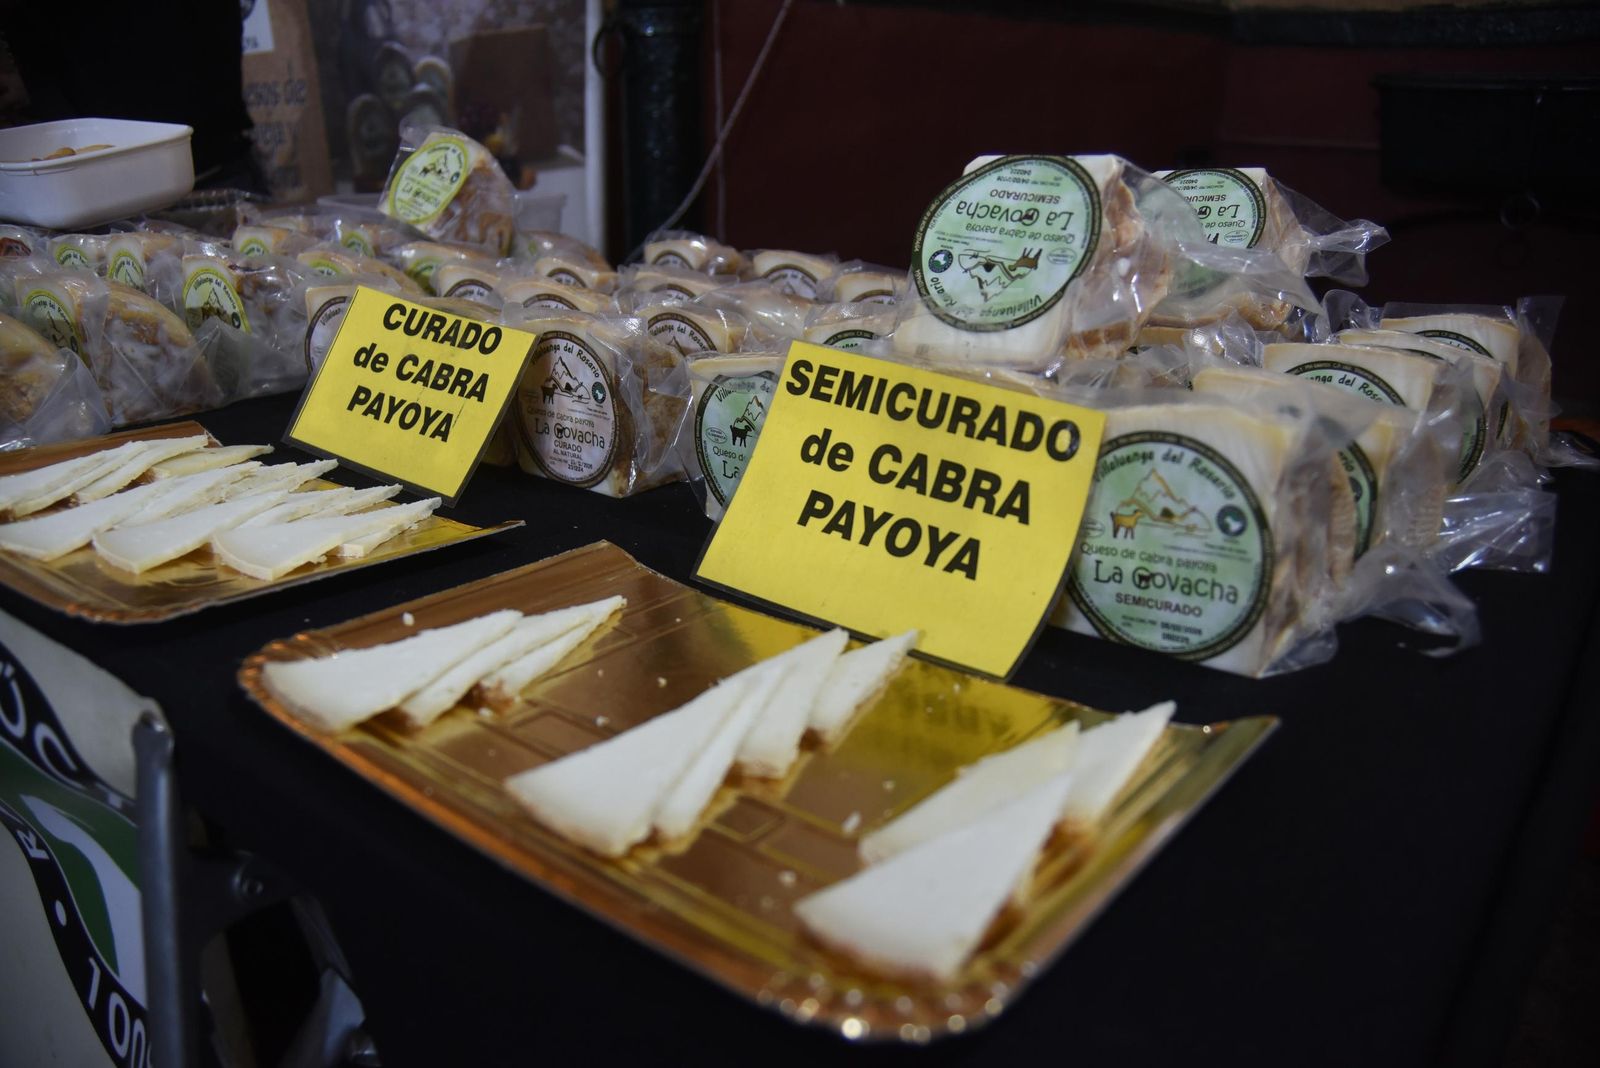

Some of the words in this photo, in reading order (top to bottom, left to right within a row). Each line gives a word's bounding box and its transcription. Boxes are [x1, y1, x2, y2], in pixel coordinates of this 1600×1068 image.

[990, 189, 1061, 205] SEMICURADO
[956, 200, 1040, 227] Covacha
[1045, 211, 1074, 231] La
[1217, 204, 1240, 219] La
[1217, 219, 1246, 229] Queso
[965, 222, 998, 235] payoya
[999, 227, 1027, 239] cabra
[1029, 232, 1042, 243] de
[1042, 233, 1076, 245] Queso
[383, 303, 503, 356] CURADO
[353, 342, 390, 374] de
[395, 354, 490, 403] CABRA
[563, 342, 574, 354] del
[576, 349, 600, 378] Rosario
[1338, 374, 1357, 387] del
[346, 385, 454, 443] PAYOYA
[556, 412, 574, 424] cabra
[785, 359, 1081, 462] SEMICURADO
[535, 417, 549, 435] La
[553, 422, 605, 449] Covacha
[553, 440, 582, 453] CURADO
[712, 445, 737, 460] Queso
[800, 428, 854, 472] de
[868, 444, 1030, 525] CABRA
[1161, 448, 1185, 465] del
[1188, 457, 1237, 500] Rosario
[797, 489, 981, 581] PAYOYA
[1080, 541, 1118, 556] Queso
[1120, 548, 1136, 560] de
[1138, 551, 1174, 567] cabra
[1094, 559, 1124, 585] La
[1132, 566, 1240, 605] Covacha
[1115, 592, 1203, 618] SEMICURADO
